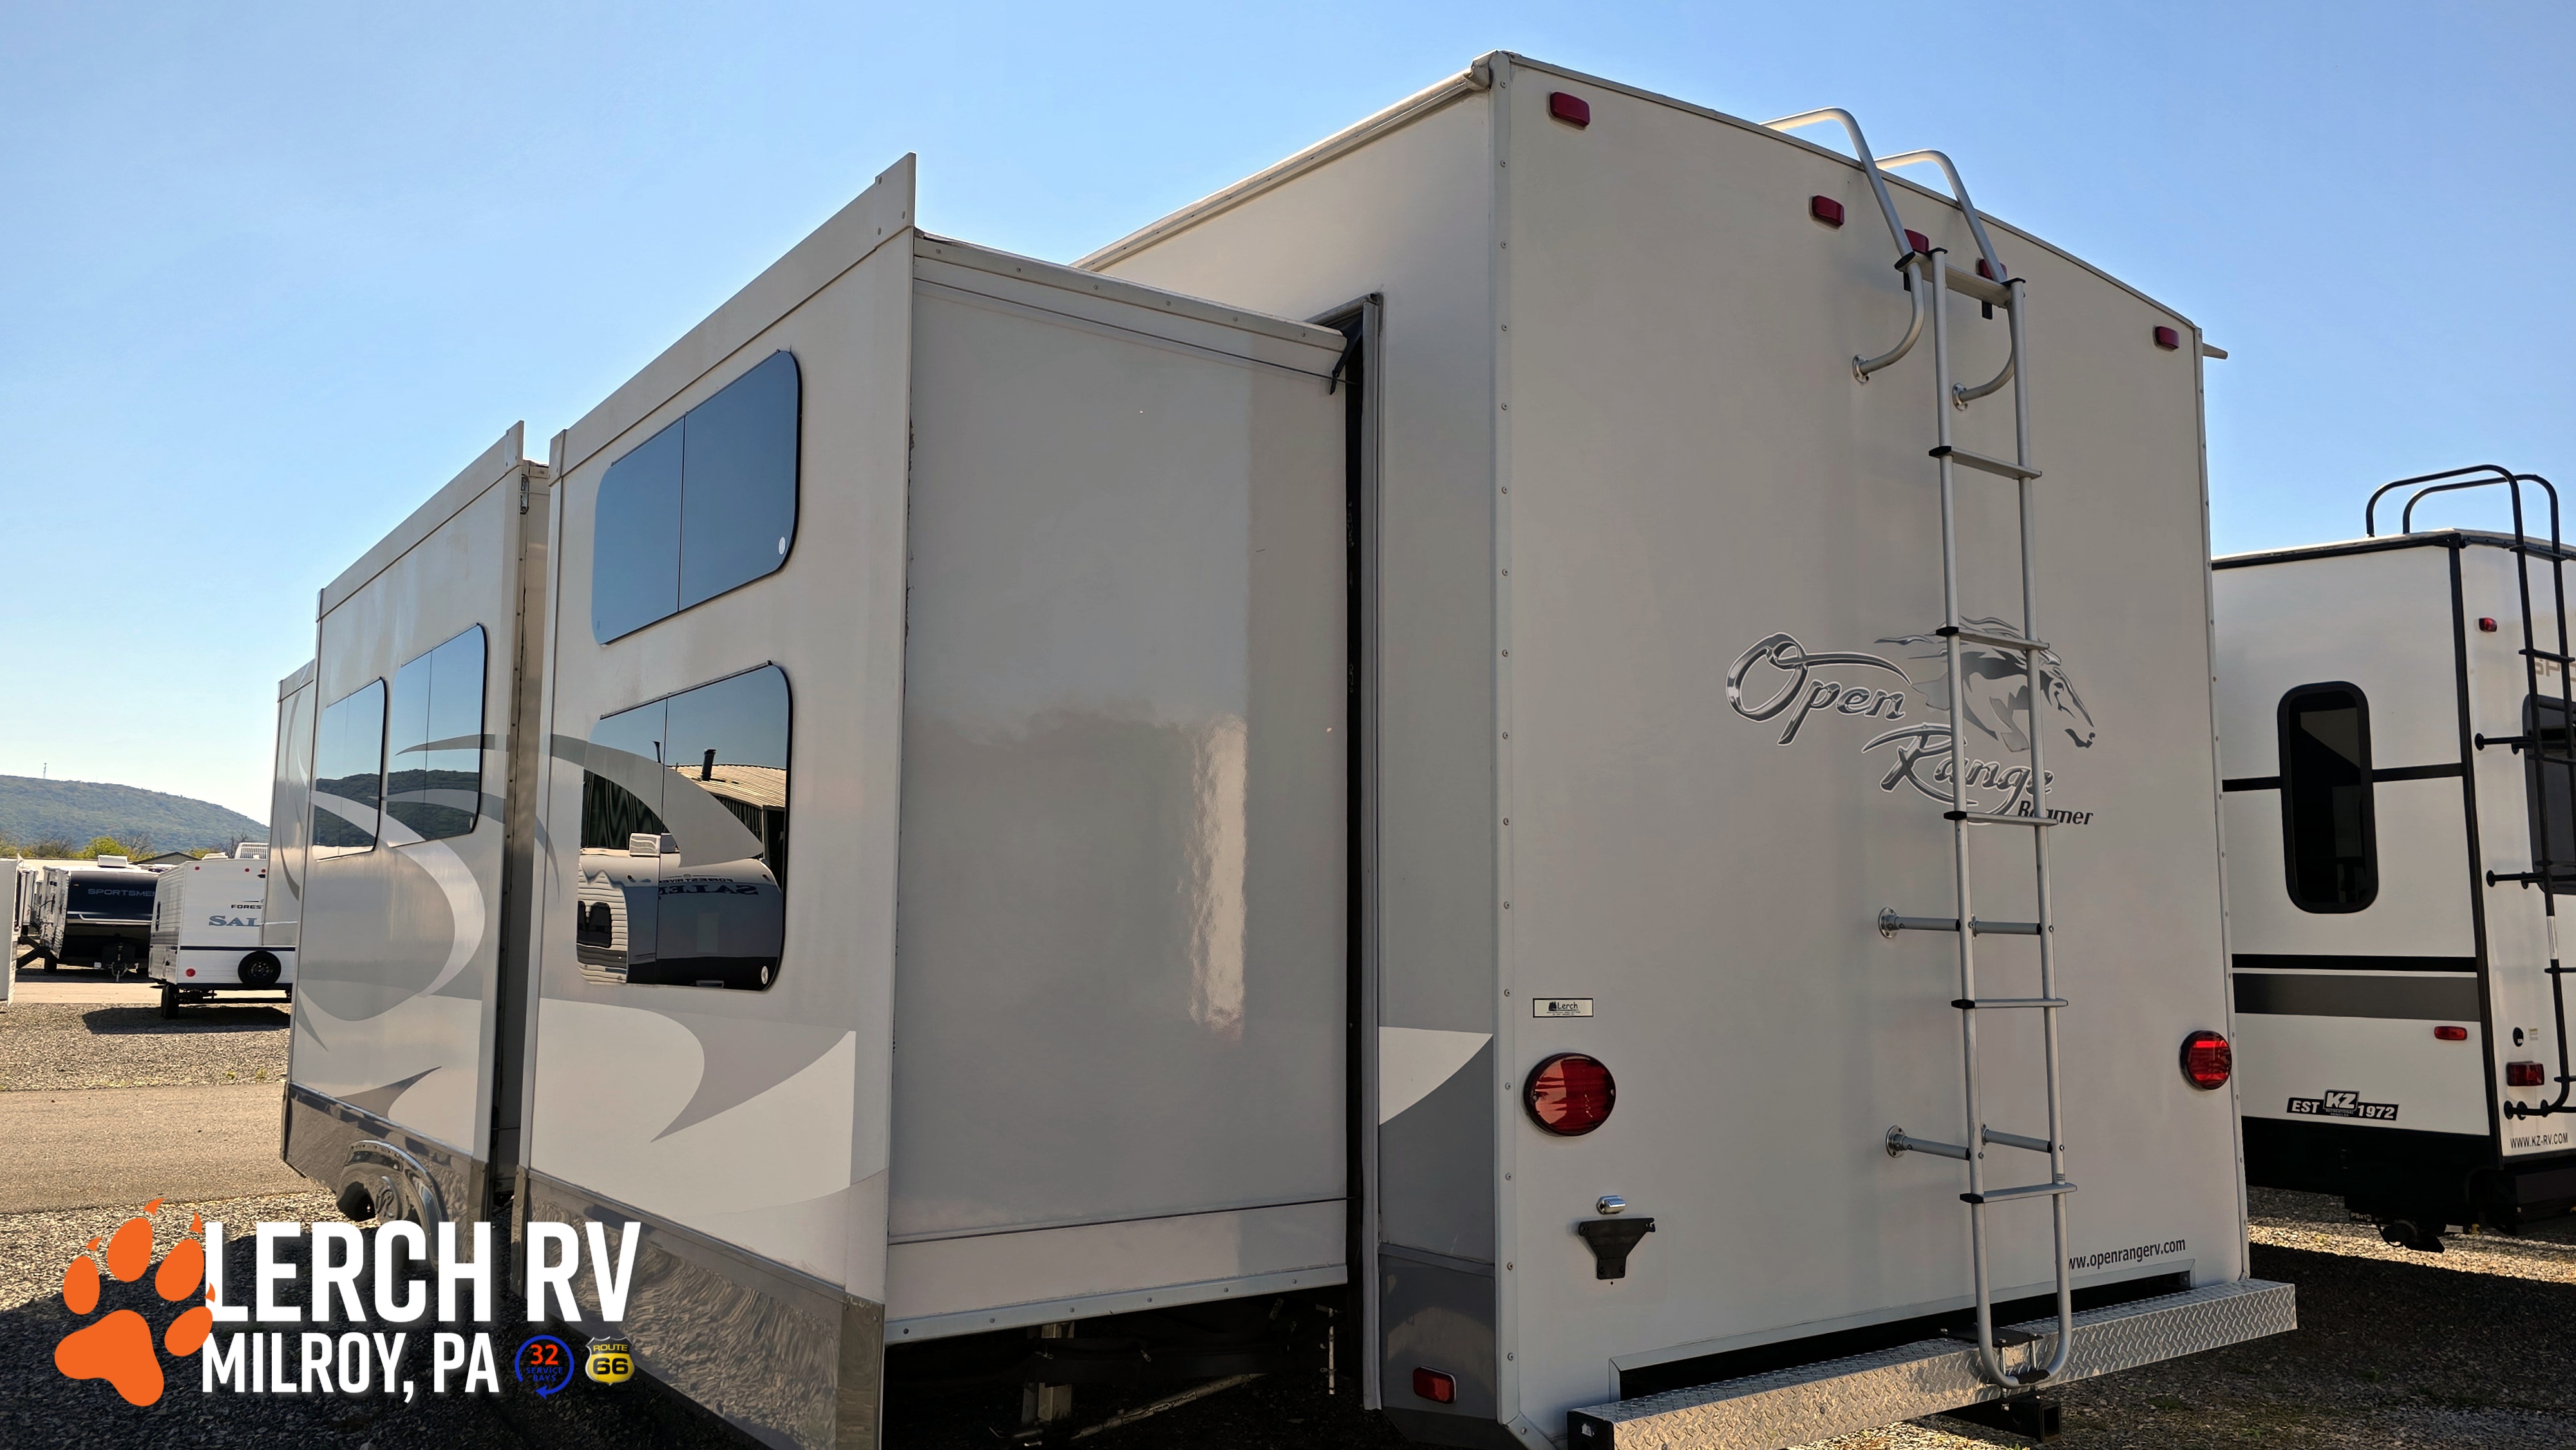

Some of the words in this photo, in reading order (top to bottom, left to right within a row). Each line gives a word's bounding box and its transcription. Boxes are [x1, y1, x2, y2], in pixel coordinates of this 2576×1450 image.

[1725, 632, 1912, 746] Open
[1861, 722, 2054, 825] Range
[1557, 1001, 1578, 1010] Lerch
[2291, 1100, 2320, 1113] EST
[2325, 1092, 2356, 1109] KZ
[2358, 1105, 2395, 1118] 1972
[2510, 1132, 2568, 1149] WWW.KZ-RV.COM
[2069, 1239, 2186, 1270] ww.openrangerv.com
